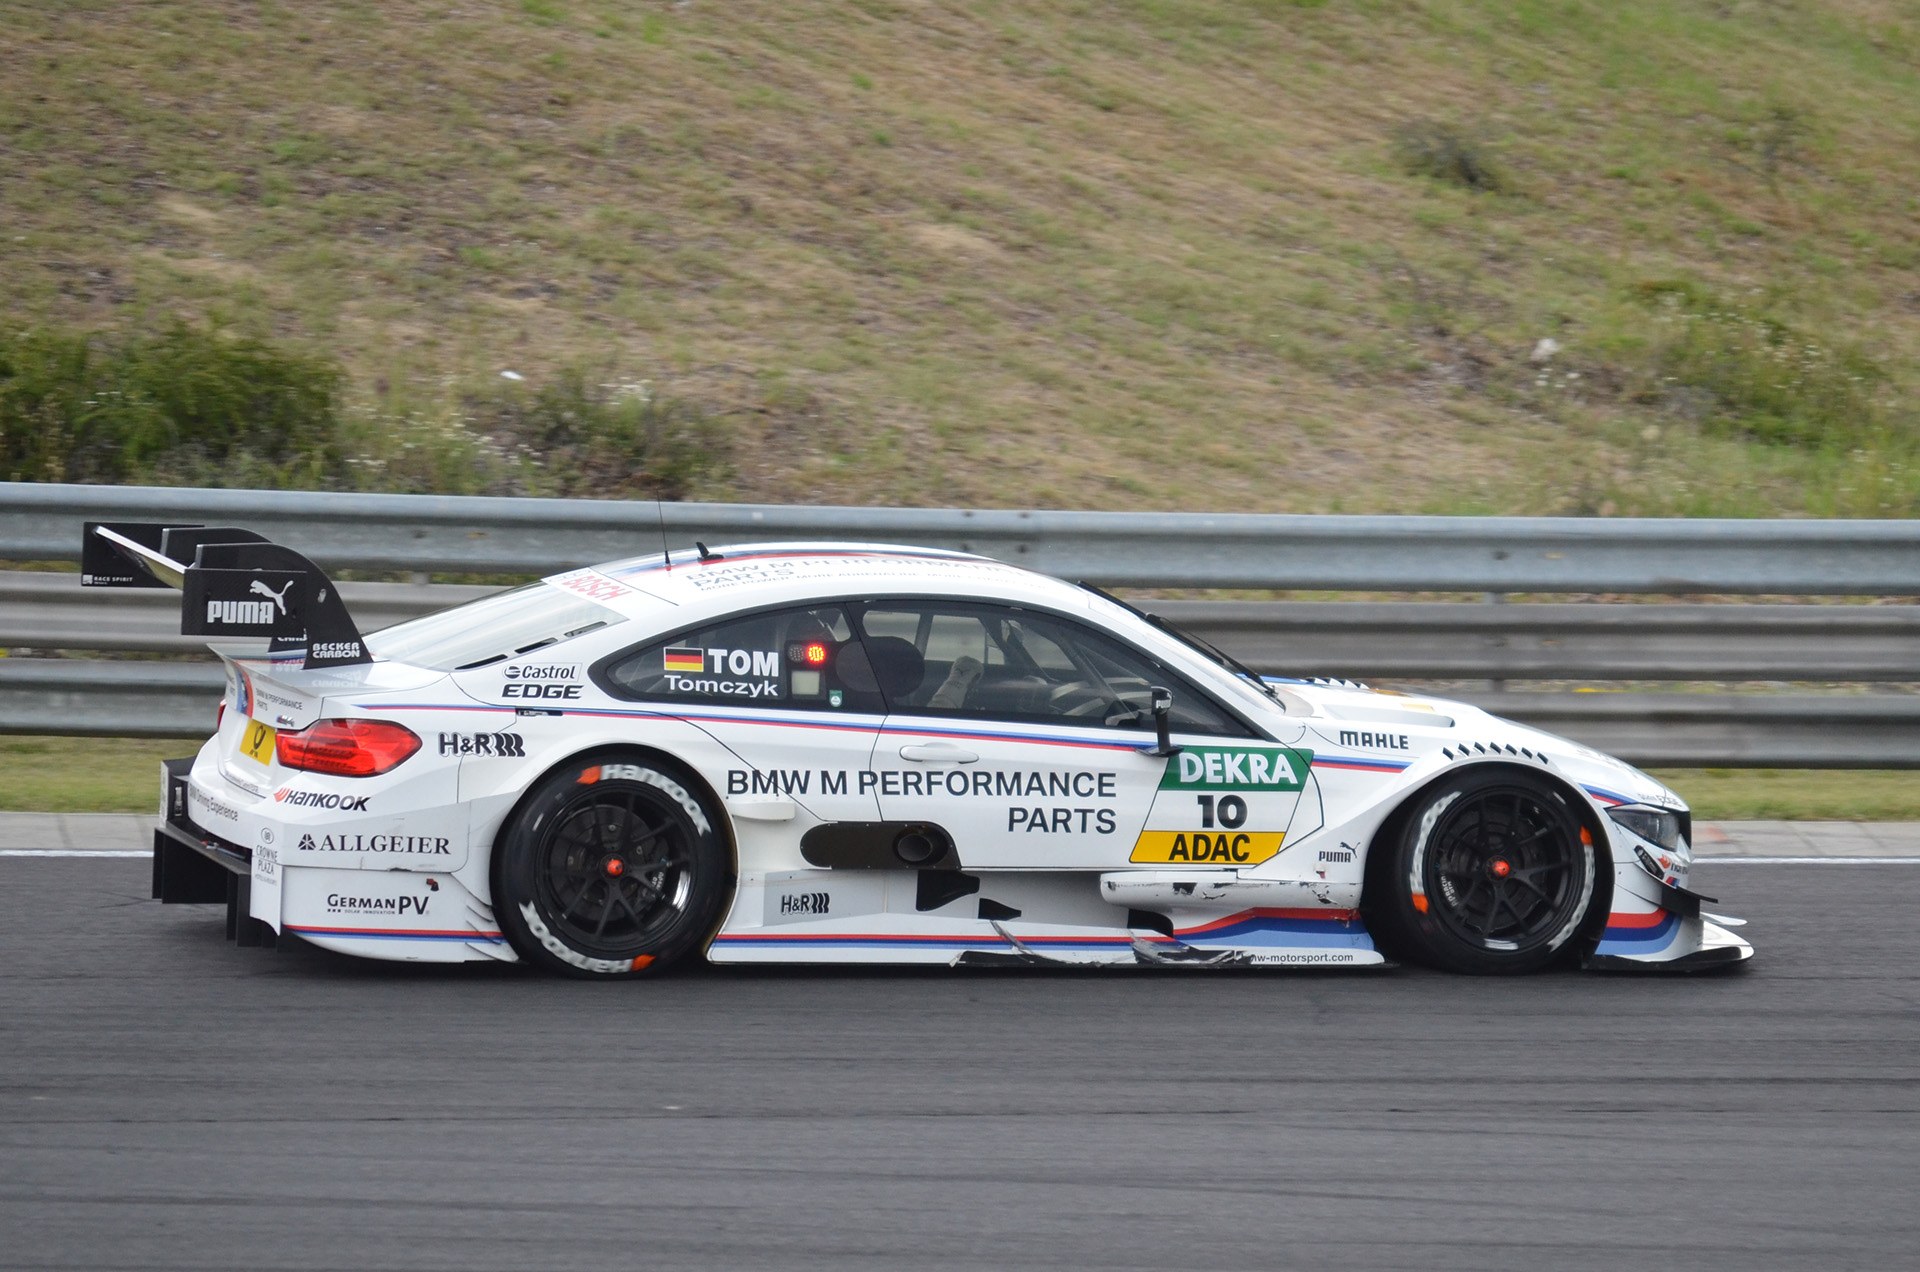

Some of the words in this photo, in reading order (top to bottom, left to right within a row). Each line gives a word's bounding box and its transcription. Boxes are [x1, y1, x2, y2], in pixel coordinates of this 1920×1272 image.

[693, 568, 795, 588] PARTS
[207, 601, 274, 624] PUMA
[312, 643, 360, 651] BECKER
[312, 650, 360, 659] CARBON
[522, 665, 576, 680] Castrol
[708, 649, 779, 678] TOM
[501, 683, 584, 699] EDGE
[664, 675, 779, 698] Tomczyk
[1340, 730, 1409, 750] MAHLE
[1179, 752, 1299, 785] DEKRA
[727, 770, 811, 795] BMW
[821, 770, 848, 795] M
[858, 770, 1117, 798] PERFORMANCE
[1008, 807, 1117, 834] PARTS
[1197, 795, 1248, 829] 10
[255, 845, 278, 863] CROWNE
[320, 834, 451, 855] ALLGEIER
[1169, 833, 1251, 862] ADAC
[257, 859, 275, 875] PLAZA
[1319, 851, 1351, 863] PUMA
